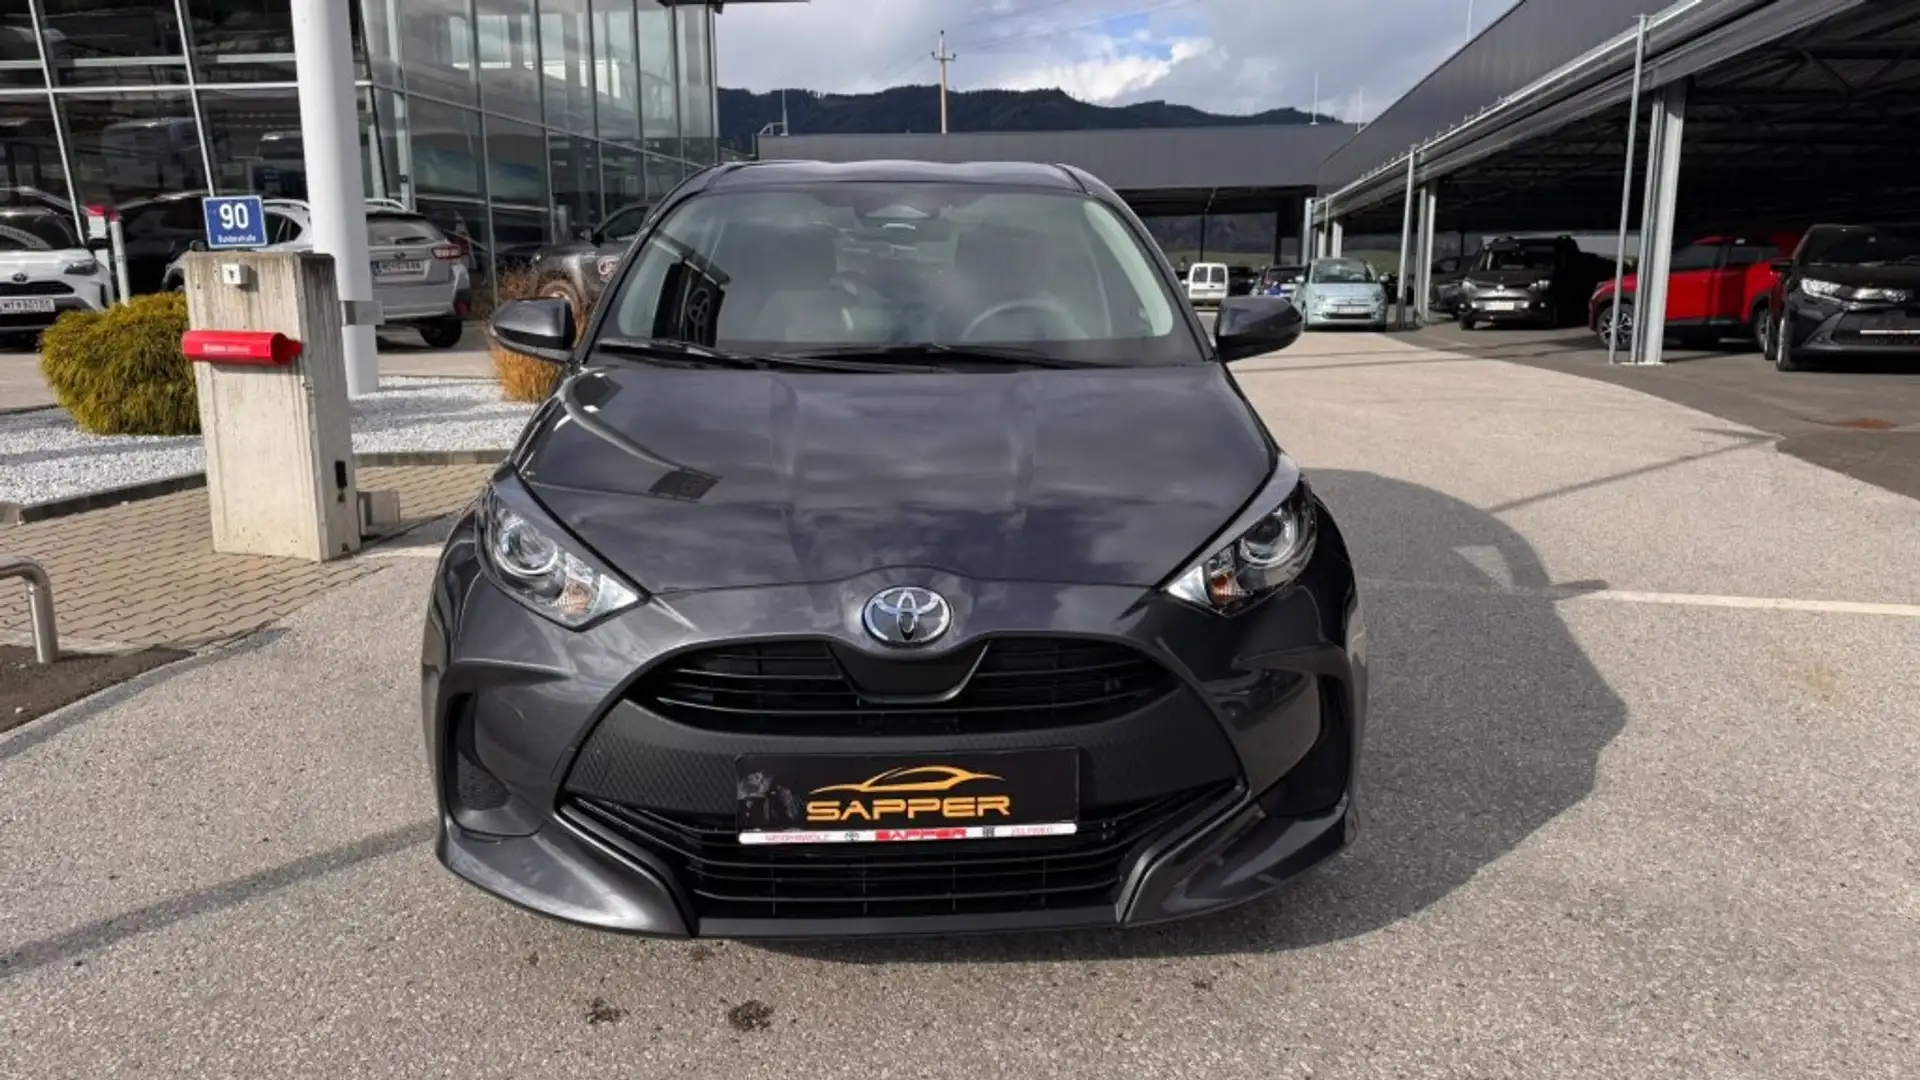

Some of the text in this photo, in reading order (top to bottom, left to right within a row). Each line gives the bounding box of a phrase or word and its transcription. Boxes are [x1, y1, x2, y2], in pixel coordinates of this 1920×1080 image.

[219, 202, 249, 229] 90
[806, 795, 1010, 821] SAPPER
[875, 827, 967, 841] SAPPER
